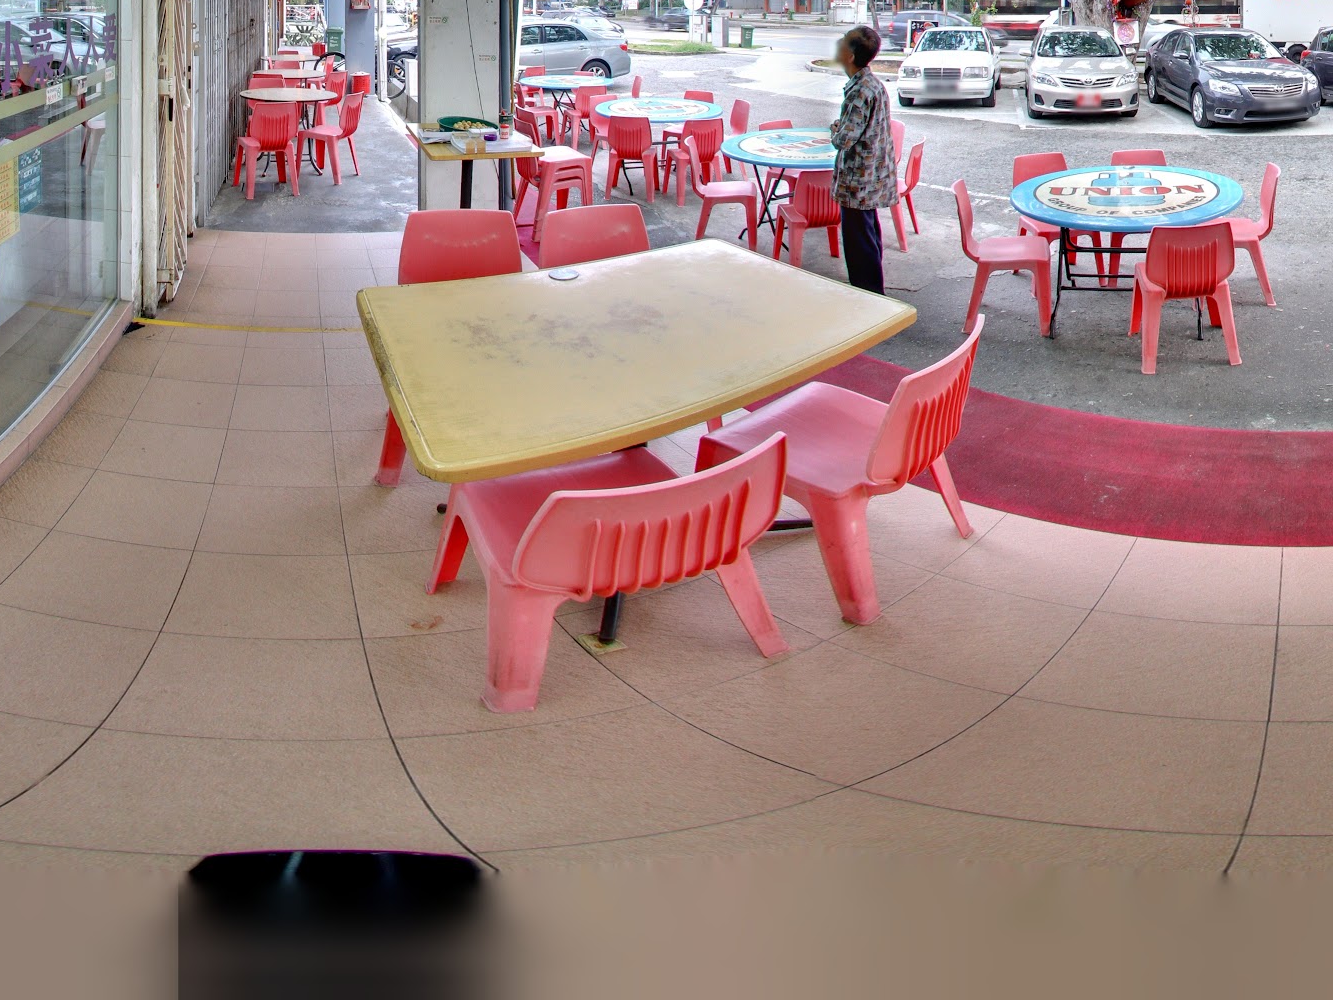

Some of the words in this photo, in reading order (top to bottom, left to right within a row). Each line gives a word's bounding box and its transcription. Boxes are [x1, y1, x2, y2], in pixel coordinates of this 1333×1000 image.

[755, 138, 833, 154] UNIO
[1049, 184, 1206, 197] UNION
[1047, 196, 1088, 213] GROUP
[1098, 208, 1122, 216] OF
[1132, 195, 1207, 216] COMPANIES
